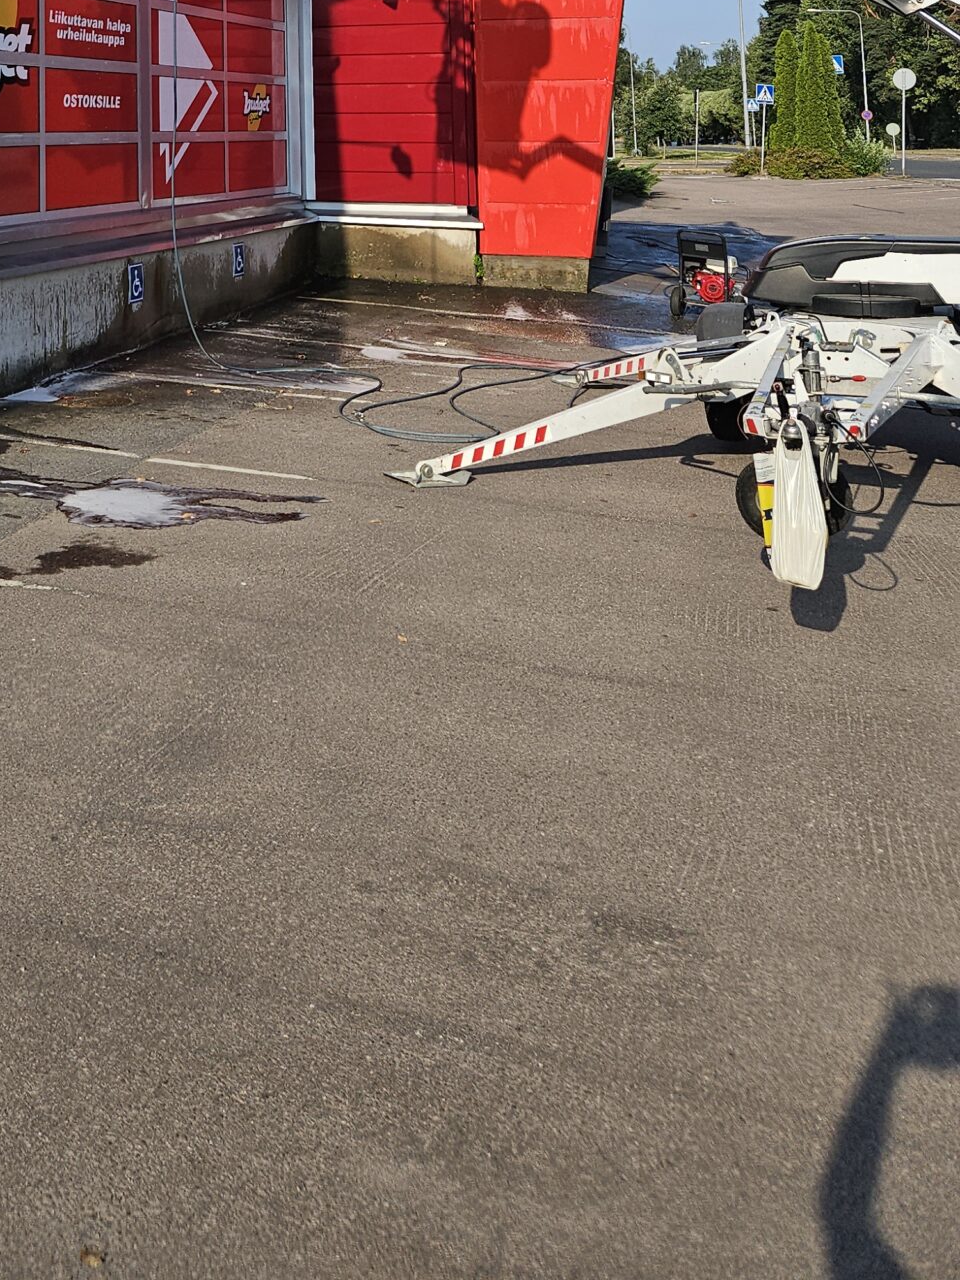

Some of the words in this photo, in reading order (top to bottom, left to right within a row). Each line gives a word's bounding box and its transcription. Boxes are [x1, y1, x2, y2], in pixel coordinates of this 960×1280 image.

[49, 10, 103, 29] Liikuttavan
[106, 18, 131, 35] halpa
[56, 27, 125, 47] urheilukauppa
[63, 94, 121, 109] OSTOKSILLE
[243, 91, 270, 116] budget
